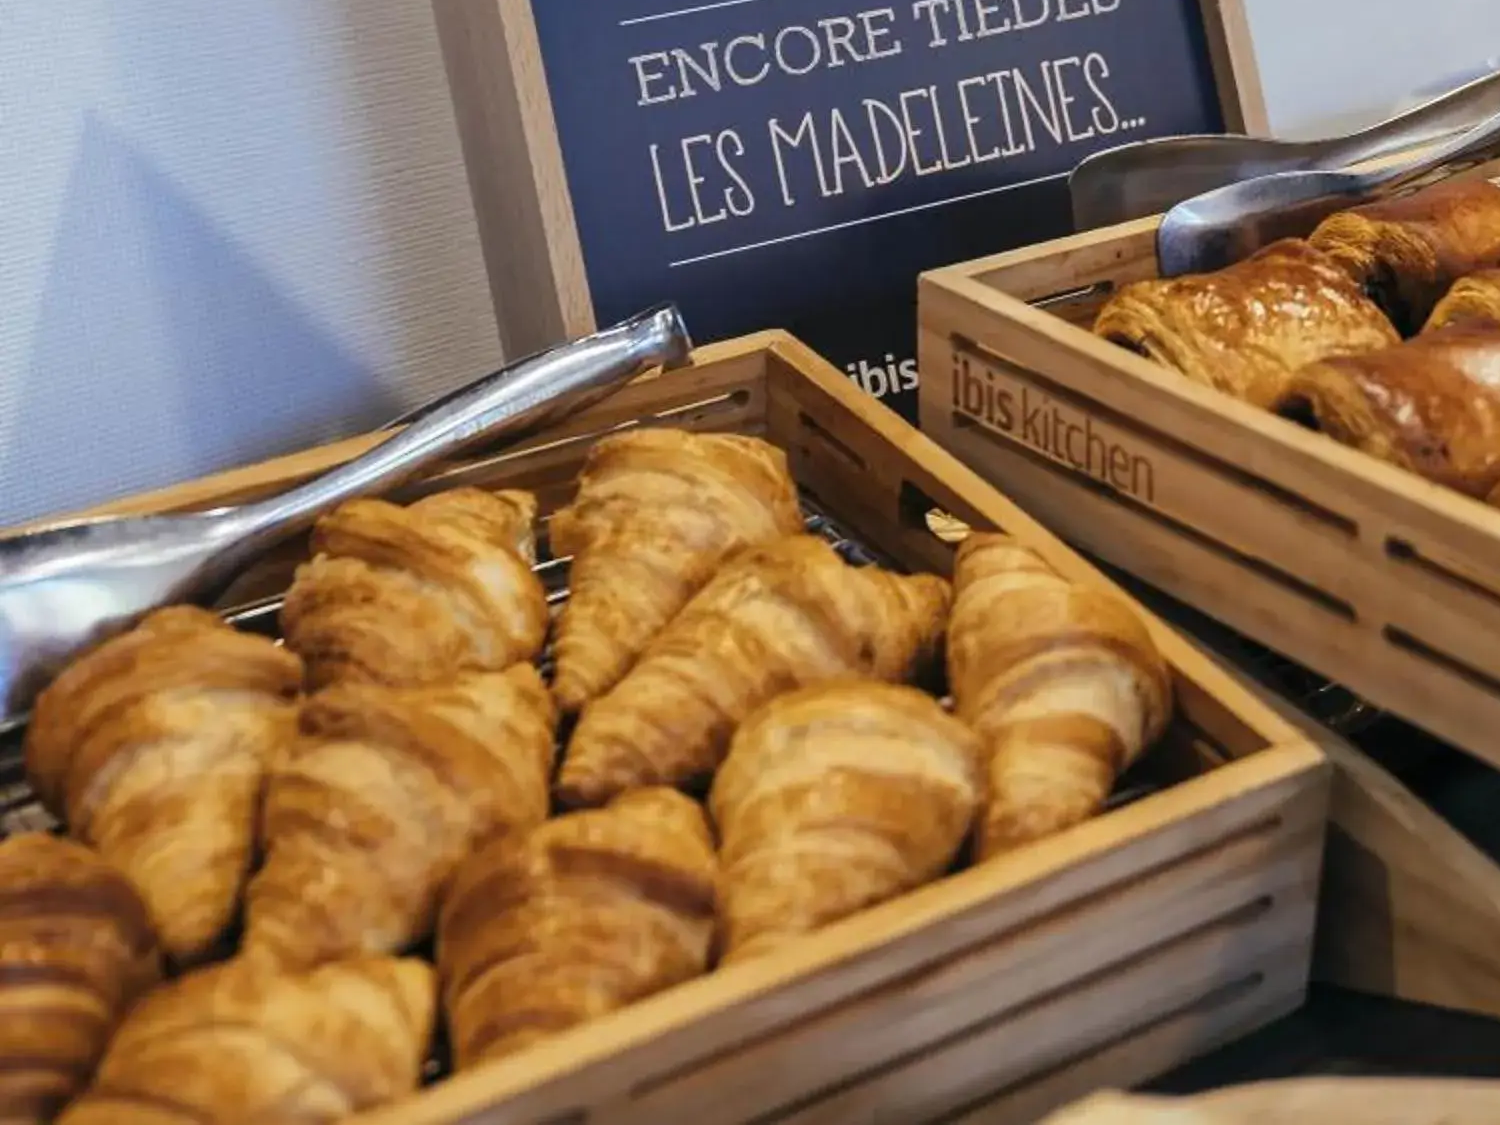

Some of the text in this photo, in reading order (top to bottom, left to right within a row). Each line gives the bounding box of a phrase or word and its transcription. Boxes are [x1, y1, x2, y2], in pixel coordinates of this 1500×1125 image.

[627, 7, 903, 108] ENCORE
[648, 51, 1148, 234] LES MADELEINES...
[951, 356, 1155, 503] ibis kitchen
